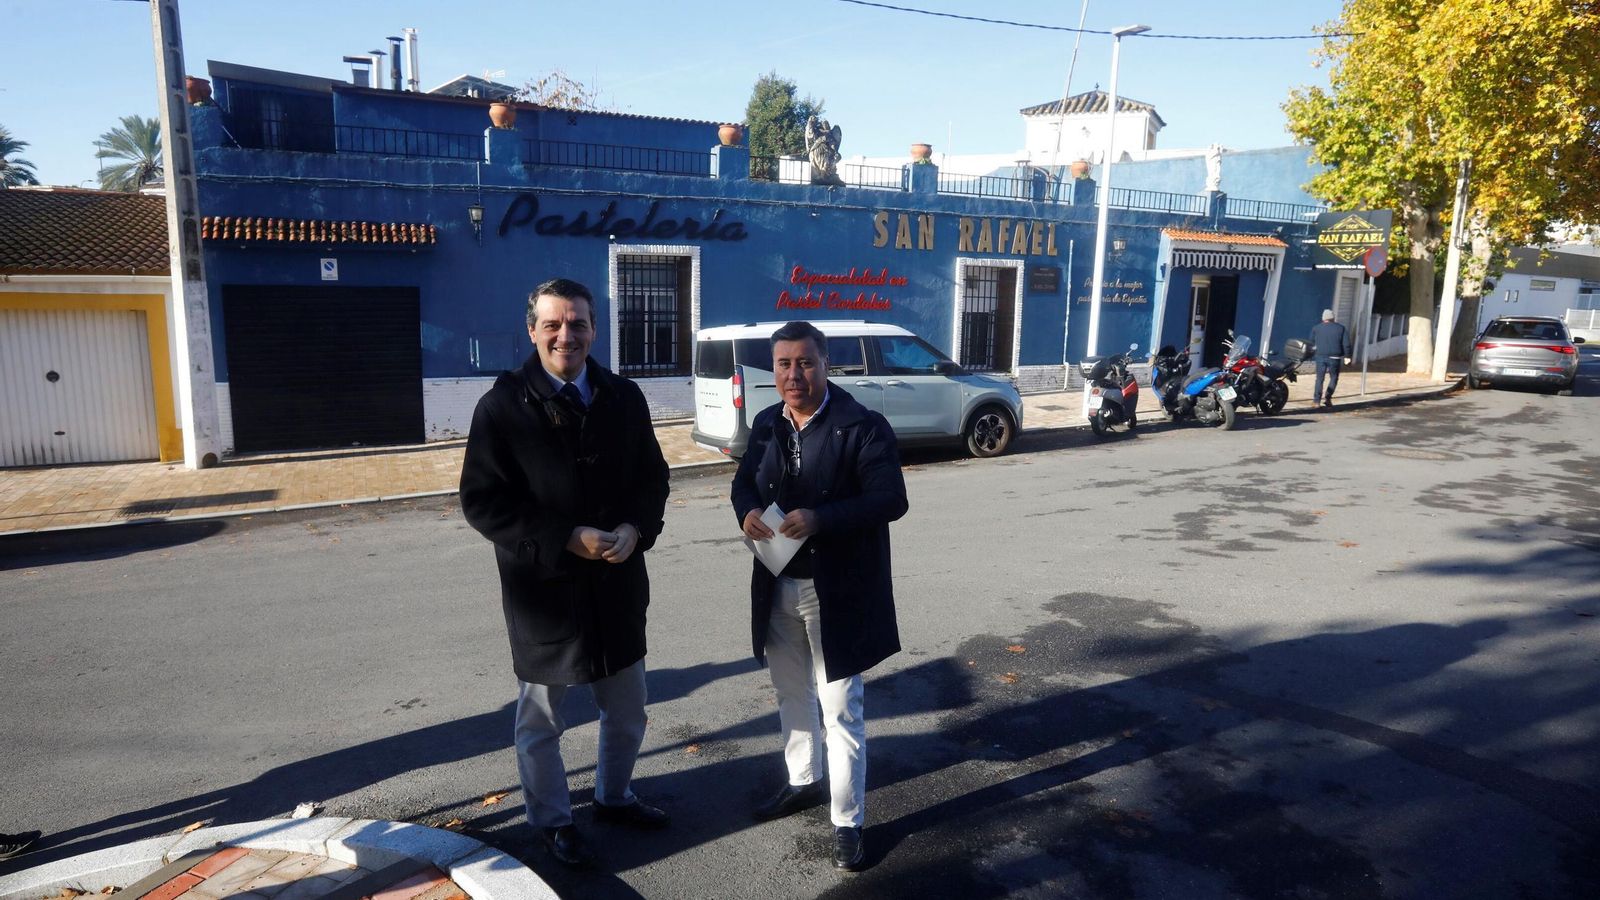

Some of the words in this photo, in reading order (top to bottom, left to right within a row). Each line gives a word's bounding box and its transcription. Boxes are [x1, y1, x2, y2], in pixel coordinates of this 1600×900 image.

[498, 193, 748, 241] Pastelería
[873, 210, 935, 250] SAN
[959, 217, 1058, 256] RAFAEL
[1318, 234, 1339, 244] SAN
[1341, 232, 1385, 243] RAFAEL
[790, 265, 888, 292] Especialidad
[889, 276, 908, 286] en
[1084, 277, 1108, 288] Prio
[1115, 278, 1122, 288] la
[1124, 280, 1143, 292] mejor
[776, 291, 824, 310] Pastel
[827, 291, 891, 311] Cordobés
[1112, 293, 1121, 303] de
[1122, 293, 1147, 306] España
